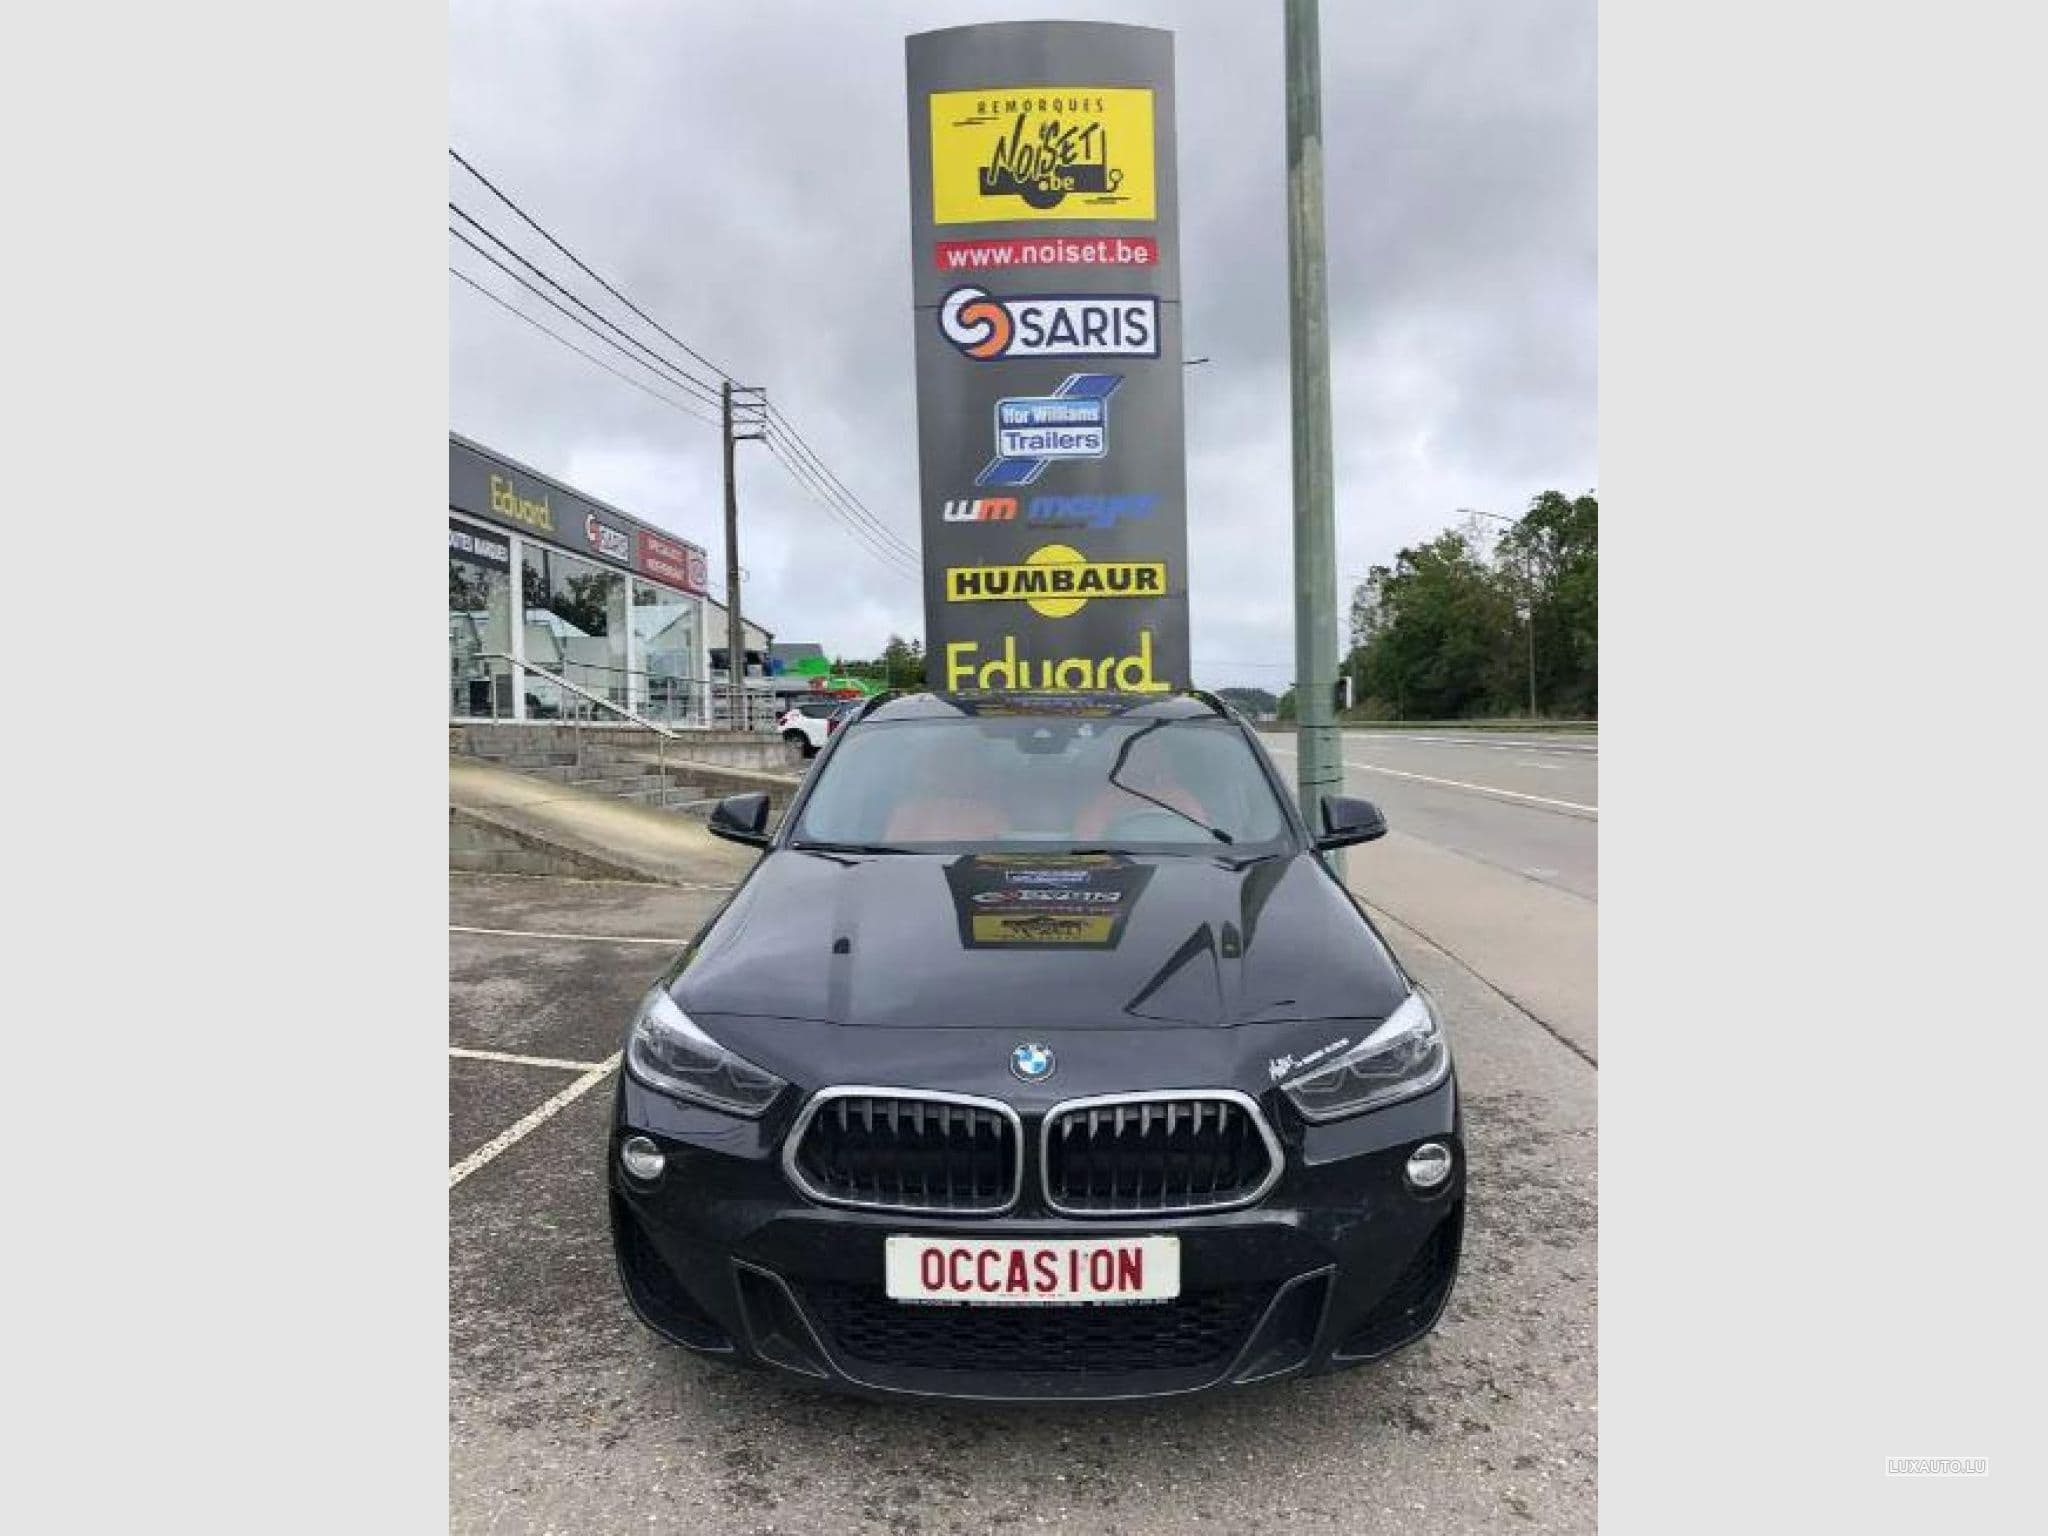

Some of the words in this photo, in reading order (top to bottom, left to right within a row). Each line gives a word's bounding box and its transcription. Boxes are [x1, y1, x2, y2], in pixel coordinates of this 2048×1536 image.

[976, 97, 1105, 114] REMORQUES
[947, 240, 1149, 266] www.noiset.be
[1020, 306, 1149, 347] SARIS
[1005, 431, 1099, 452] Trailers
[955, 567, 1159, 595] HUMBAUR
[946, 632, 1171, 692] Eduard
[920, 1247, 1143, 1293] OCCASION
